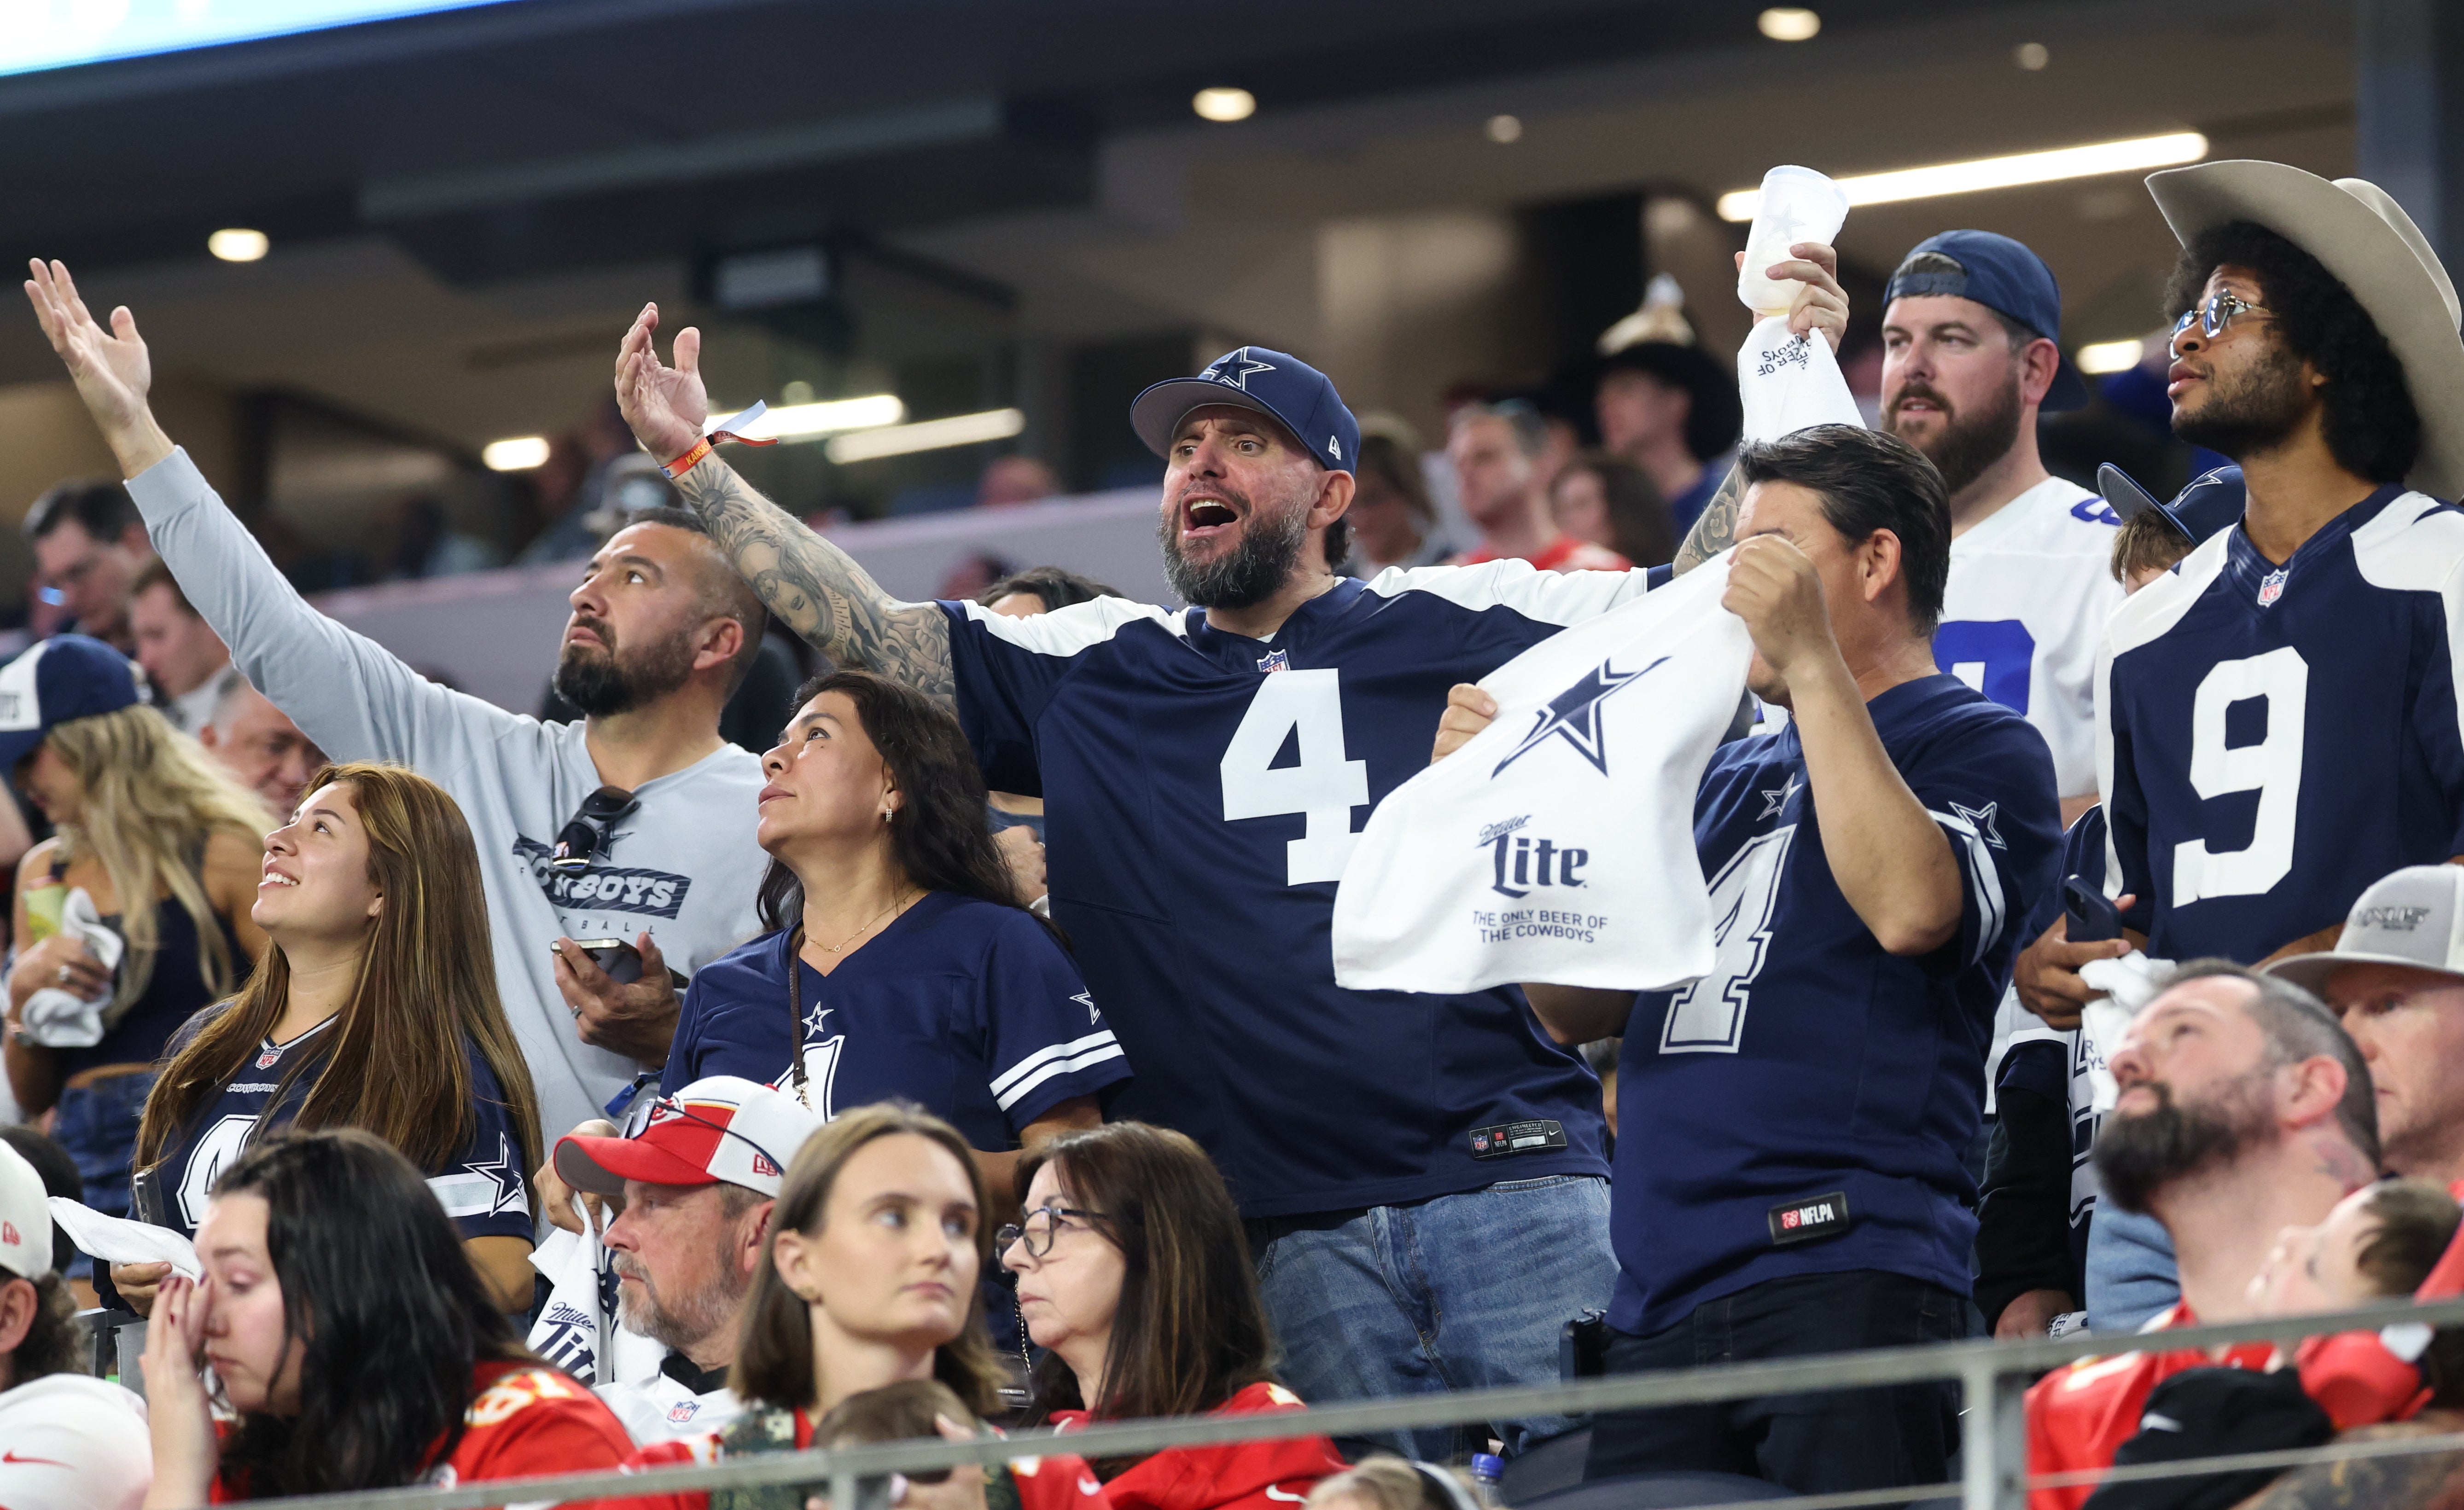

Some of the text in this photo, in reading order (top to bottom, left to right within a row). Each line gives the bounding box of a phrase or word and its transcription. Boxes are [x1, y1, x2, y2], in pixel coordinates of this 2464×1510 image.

[1758, 364, 1775, 376] OF
[685, 441, 709, 466] KANSAS
[2261, 584, 2279, 600] NFL
[1220, 668, 1370, 886] 4
[2173, 646, 2309, 908] 9
[1479, 814, 1532, 838] Miller
[1475, 832, 1589, 899] Lite
[1473, 910, 1608, 930] THE ONLY BEER OF
[1480, 924, 1595, 944] THE COWBOYS
[1659, 824, 1797, 1055] 4
[259, 1055, 275, 1066] NFL
[226, 1083, 280, 1094] COWBOYS
[1476, 1139, 1508, 1149] NFL NFLPA
[1800, 1202, 1835, 1226] NFLPA
[548, 1301, 597, 1333] Miller
[670, 1409, 690, 1420] NFL
